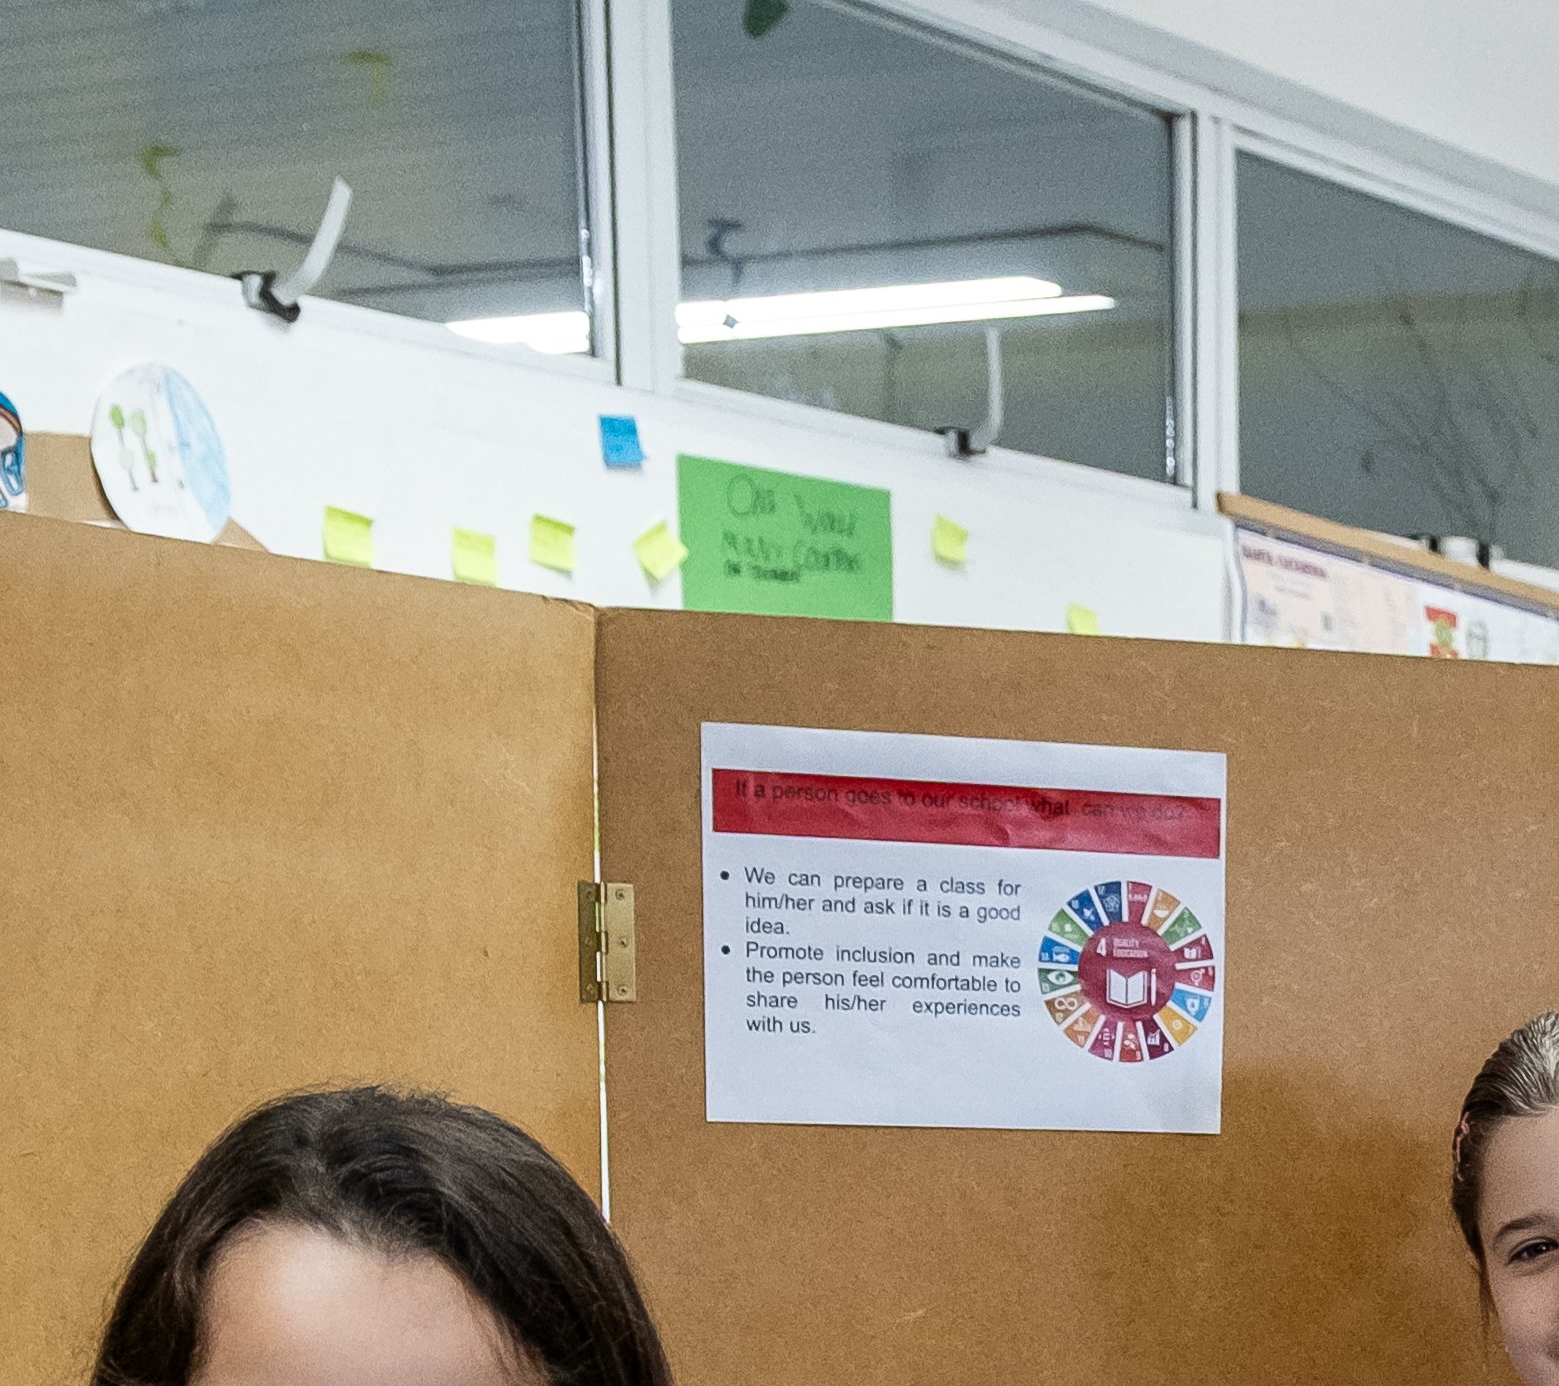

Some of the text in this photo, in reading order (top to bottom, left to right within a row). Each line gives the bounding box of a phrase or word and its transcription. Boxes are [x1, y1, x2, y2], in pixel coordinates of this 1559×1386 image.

[735, 780, 748, 798] If
[754, 783, 766, 799] a
[772, 785, 839, 802] person
[845, 787, 891, 807] goes
[896, 789, 916, 806] to
[920, 792, 955, 809] our
[745, 867, 1021, 896] We can prepare a class for
[745, 893, 1021, 923] him/her and ask if it is a good
[745, 917, 790, 935] idea.
[746, 942, 1021, 968] Promote inclusion and make
[1096, 938, 1107, 957] 4
[746, 968, 1021, 993] the person feel comfortable to
[746, 991, 1021, 1018] share his/her experiences
[746, 1017, 816, 1034] with us.
